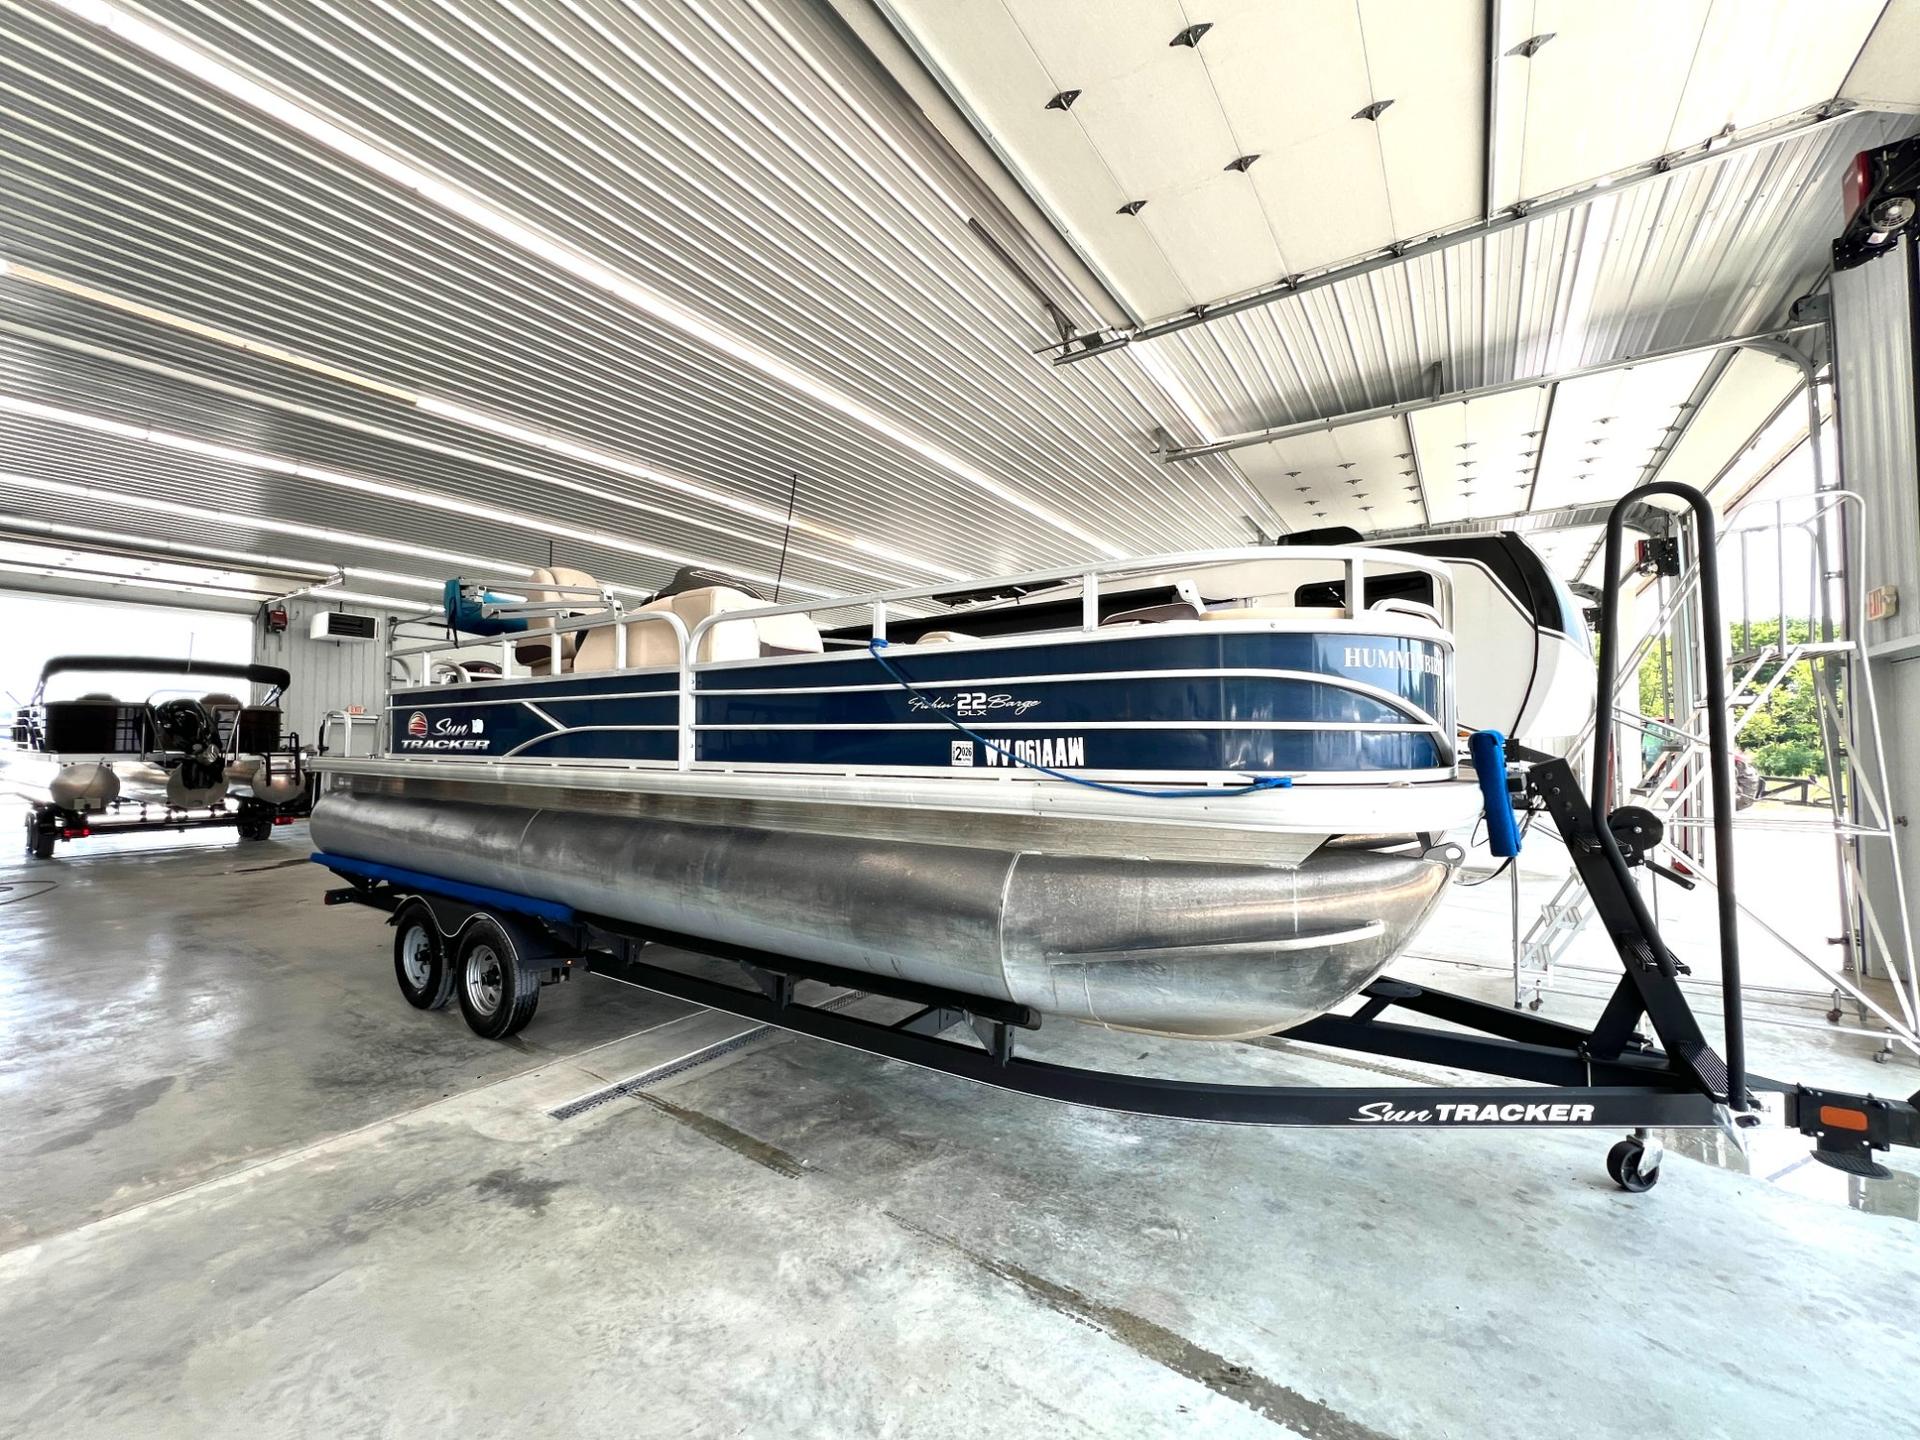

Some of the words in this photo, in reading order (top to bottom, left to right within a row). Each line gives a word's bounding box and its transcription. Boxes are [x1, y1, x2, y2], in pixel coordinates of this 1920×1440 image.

[957, 692, 987, 710] 22
[987, 694, 1042, 716] Barge
[431, 718, 469, 737] Sun
[401, 739, 490, 751] TRACKER
[984, 738, 1011, 766] WV
[1348, 1102, 1433, 1122] Sun
[1435, 1103, 1595, 1122] TRACKER
